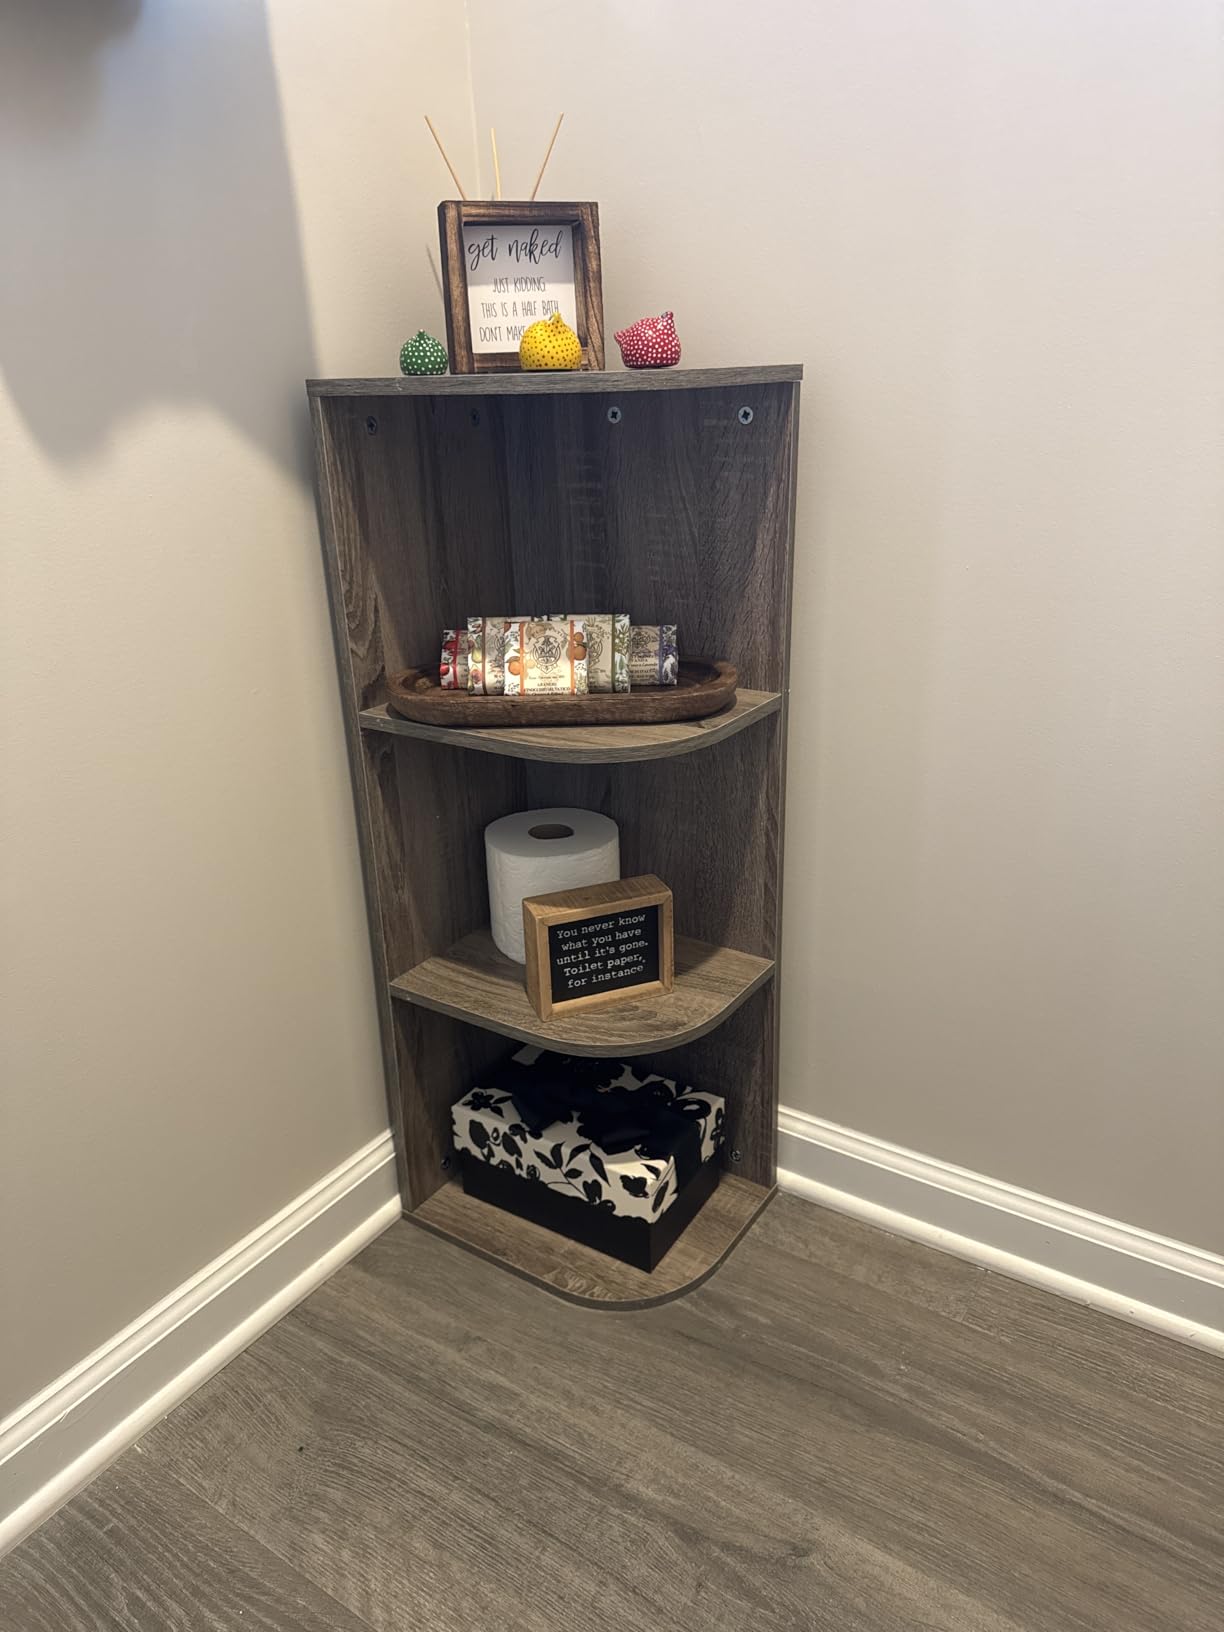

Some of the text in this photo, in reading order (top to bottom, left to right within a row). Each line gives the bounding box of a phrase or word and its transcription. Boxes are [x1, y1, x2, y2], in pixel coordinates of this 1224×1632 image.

[467, 228, 563, 271] get naked
[492, 276, 546, 293] JUST KIDDING
[481, 300, 559, 319] THIS IS A HALF BATH
[556, 914, 646, 939] You never know
[562, 928, 642, 951] what you have
[556, 940, 648, 965] until it's gone.
[564, 953, 642, 976] Toilet paper,
[568, 964, 644, 988] for instance
